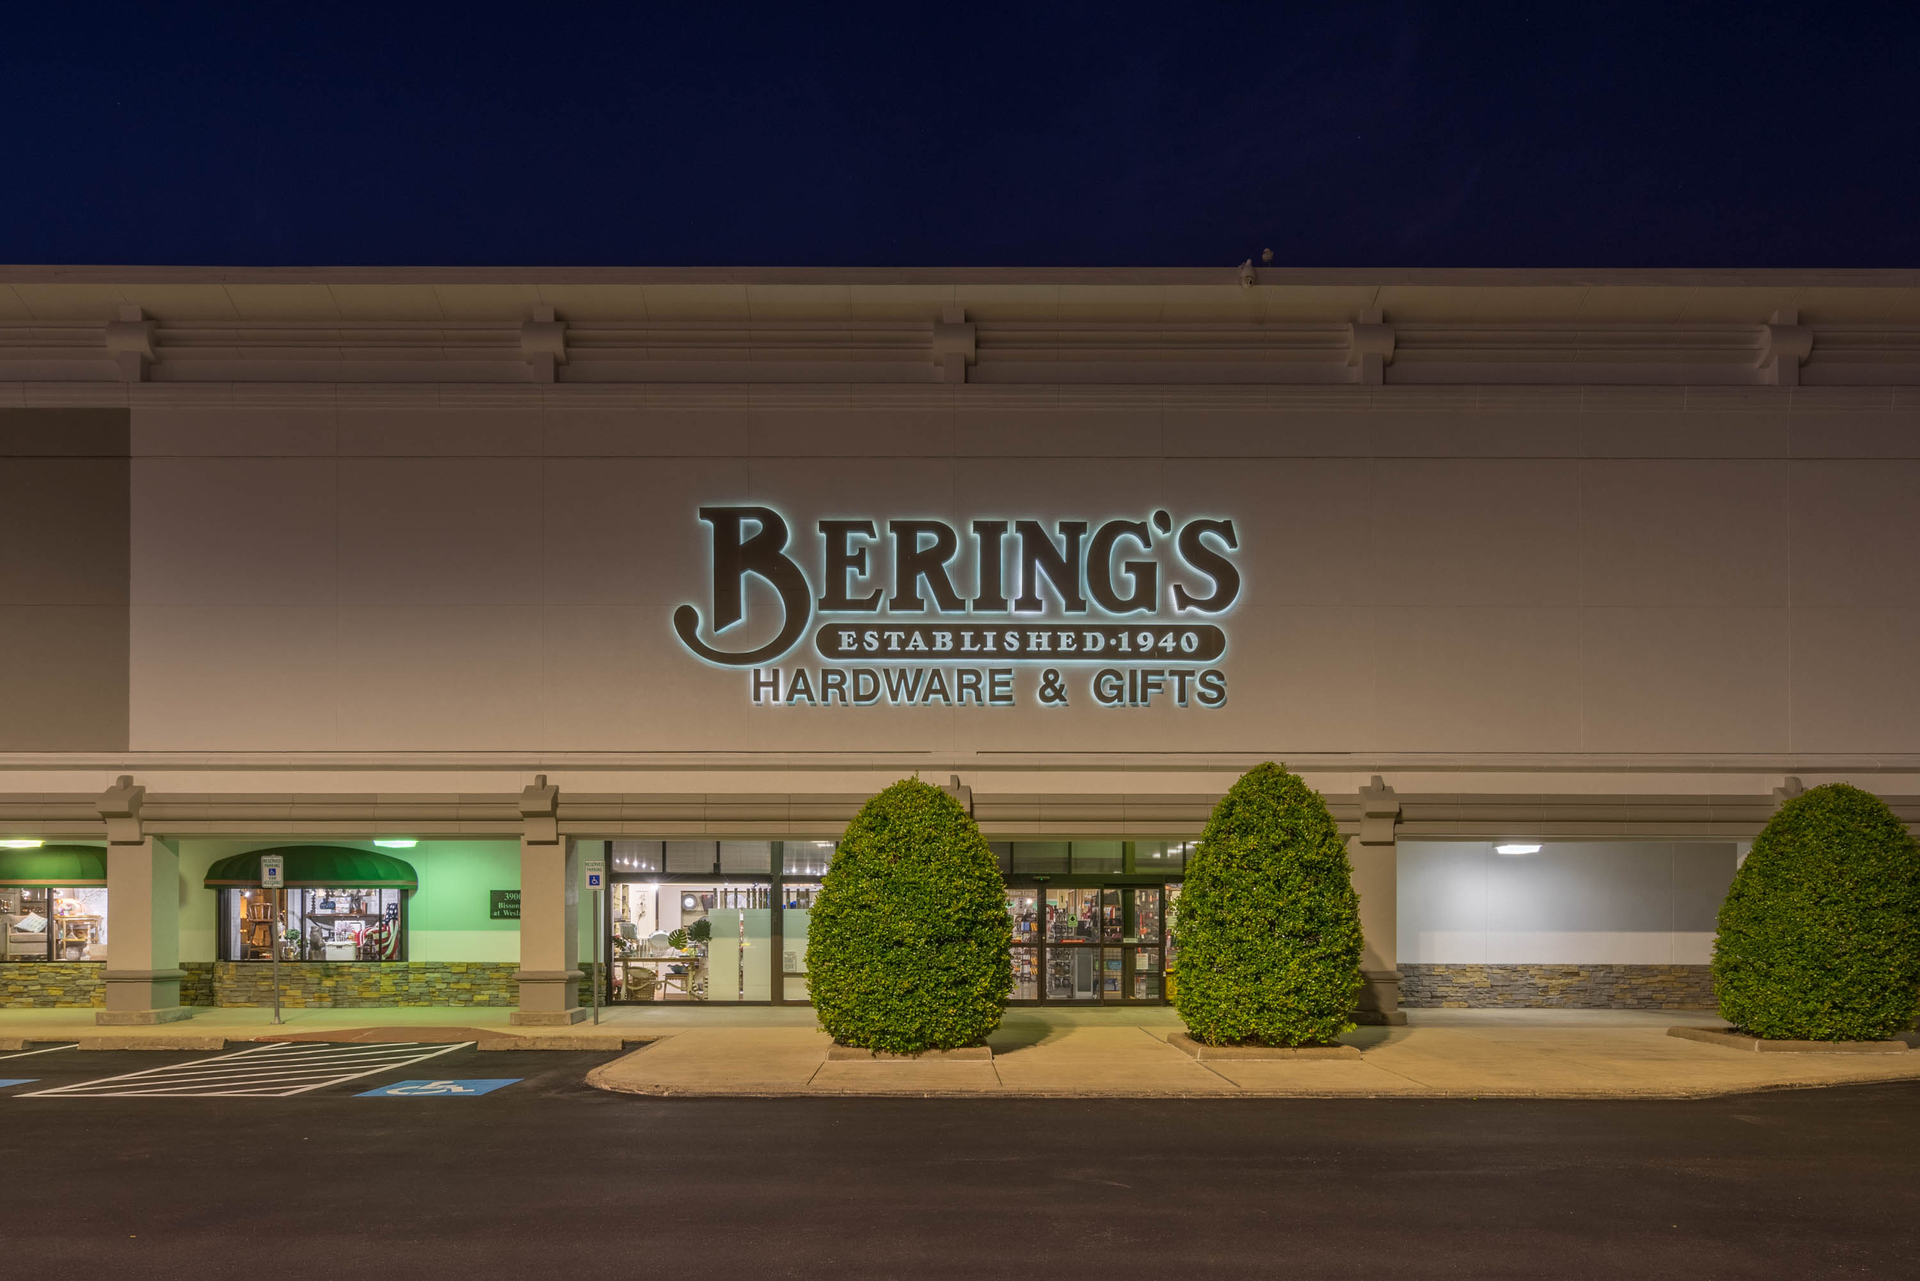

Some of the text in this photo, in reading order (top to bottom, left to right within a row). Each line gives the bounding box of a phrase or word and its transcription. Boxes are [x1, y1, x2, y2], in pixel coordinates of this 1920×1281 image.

[753, 667, 1227, 705] HARDWARE & GIFTS
